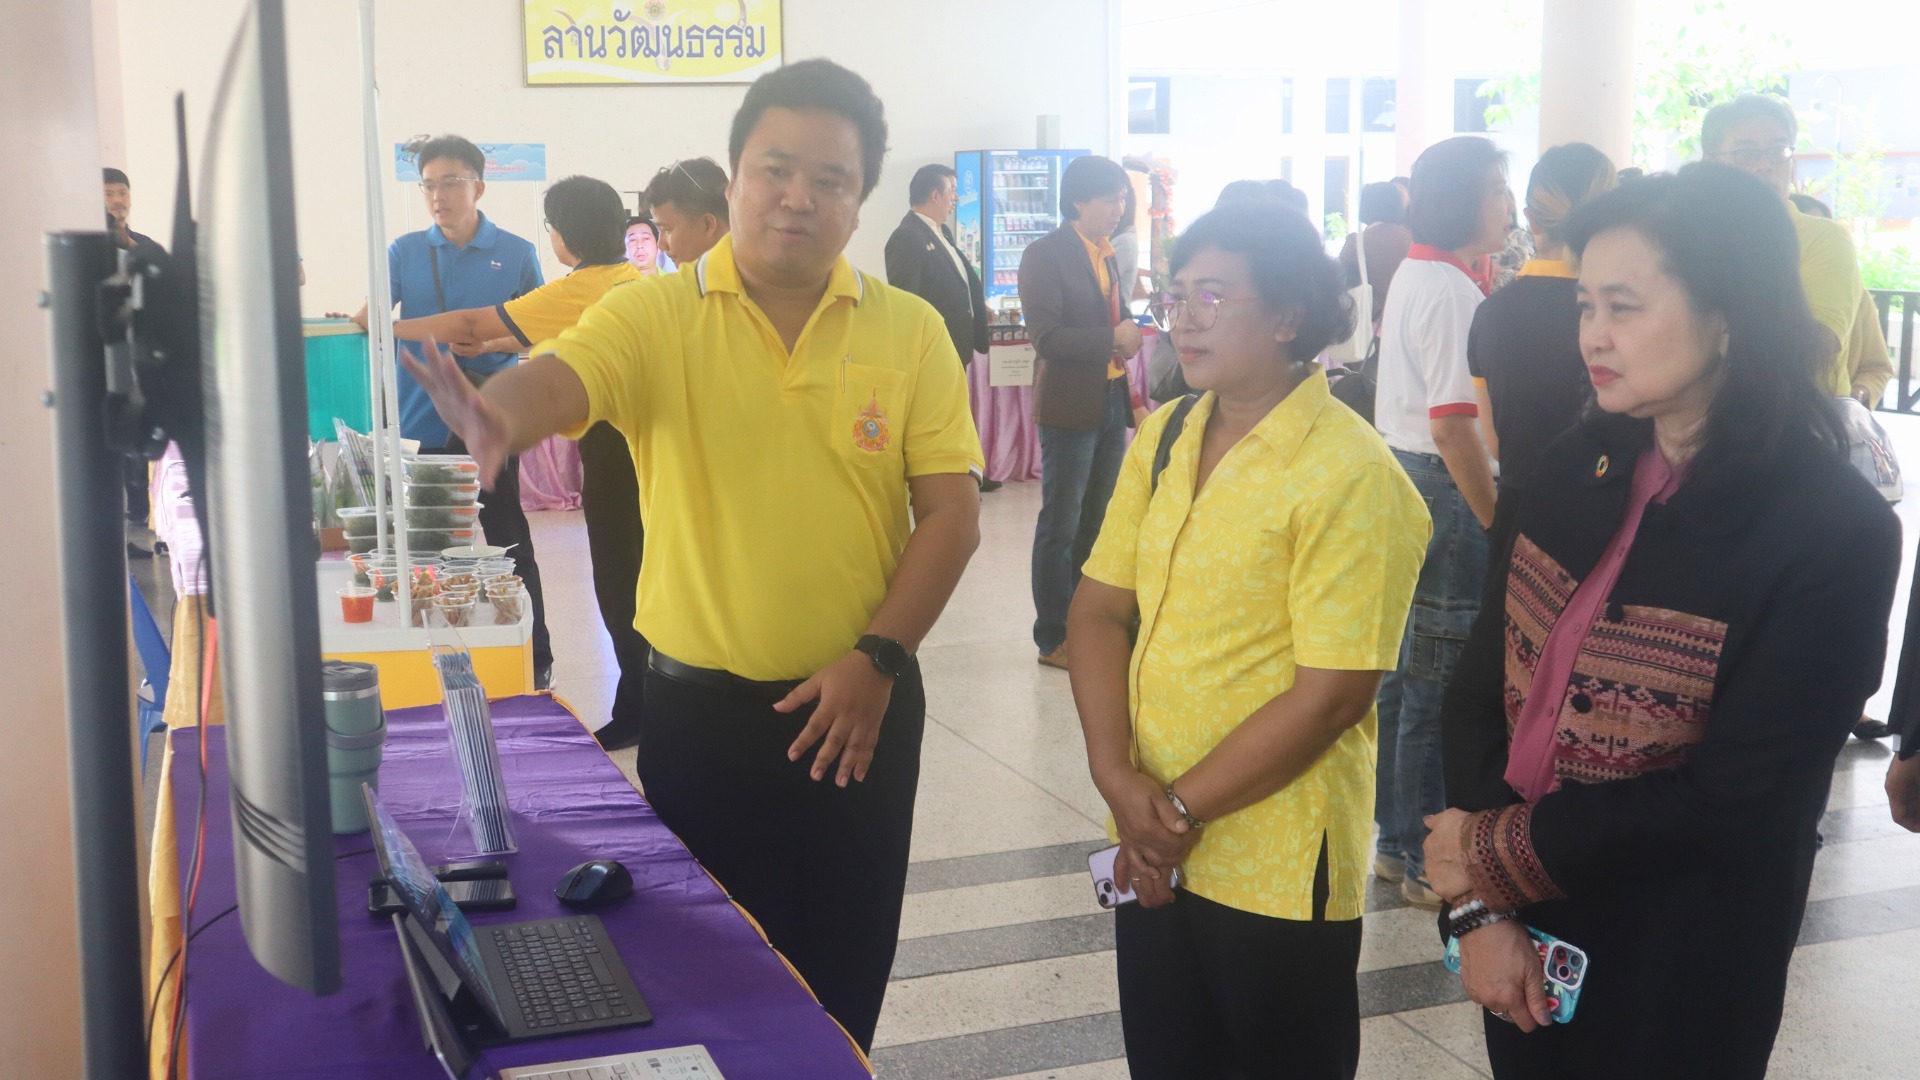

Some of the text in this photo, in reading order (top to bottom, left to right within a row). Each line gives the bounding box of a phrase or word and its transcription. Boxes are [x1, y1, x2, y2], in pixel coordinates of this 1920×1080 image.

[542, 9, 766, 58] ลานวัฒนธรรม
